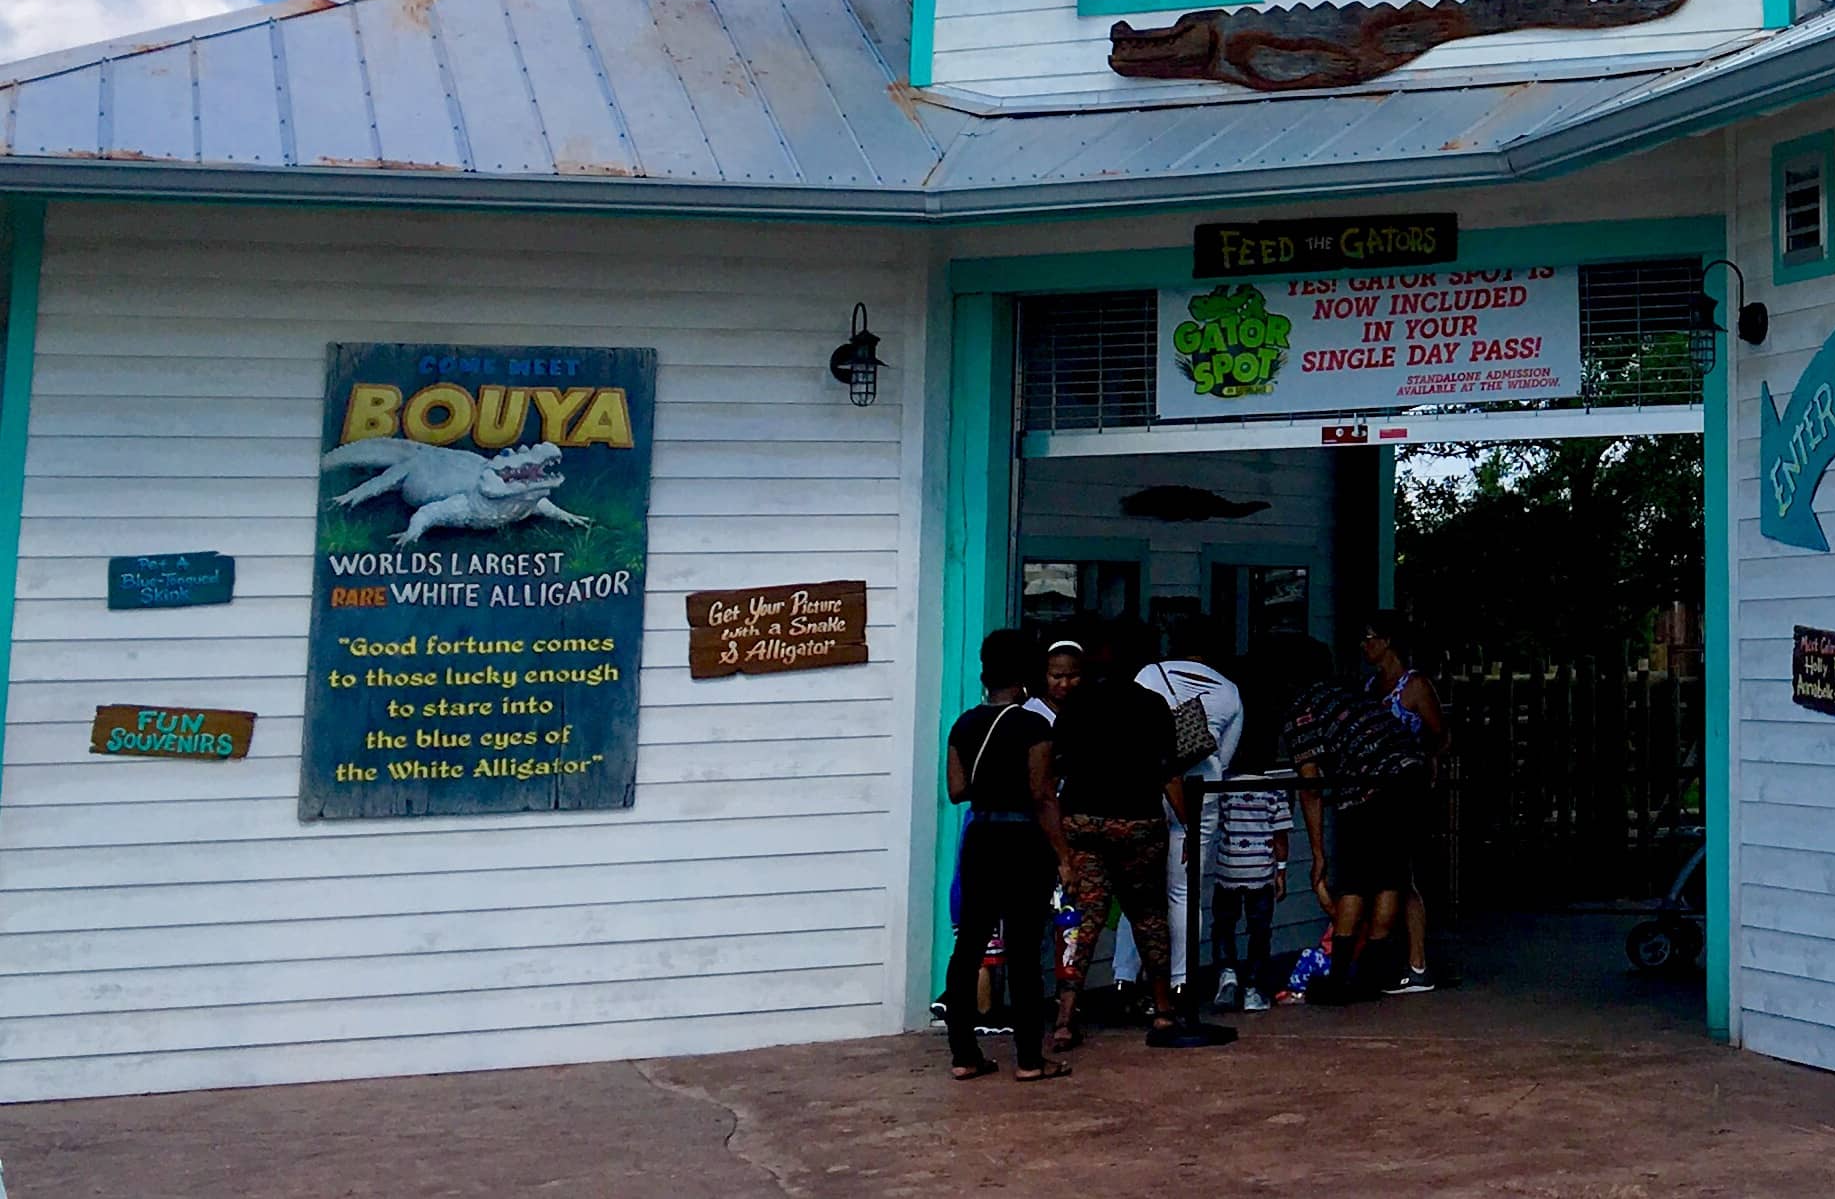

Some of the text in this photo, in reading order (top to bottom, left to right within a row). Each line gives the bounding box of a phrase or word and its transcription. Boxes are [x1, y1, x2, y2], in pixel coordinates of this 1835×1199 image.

[1219, 227, 1436, 269] FEED THE GATORS
[1287, 267, 1554, 296] YES! GATOR SPOT IS
[1312, 286, 1527, 320] NOW INCLUDED
[1173, 313, 1291, 354] GATOR
[1362, 315, 1477, 342] IN YOUR
[419, 355, 496, 375] COME
[1302, 337, 1542, 372] SINGLE DAY PASS!
[1194, 347, 1280, 394] SPOT
[1407, 368, 1551, 384] STANDALONE ADMISSION
[1396, 383, 1456, 396] AVAILABLE
[1460, 382, 1476, 392] AT
[1480, 381, 1503, 391] THE
[340, 382, 634, 448] BOUYA
[329, 552, 564, 576] WORLDS LARGEST
[331, 571, 629, 607] RARE WHITE ALLIGATOR
[709, 591, 842, 626] Get Your Picture
[721, 625, 760, 640] with
[769, 623, 780, 635] a
[426, 636, 524, 655] fortune
[533, 637, 614, 652] comes
[744, 639, 835, 665] Alligator
[329, 664, 619, 689] to those lucky enough
[388, 697, 553, 718] to stare into
[138, 710, 204, 733] FUN
[107, 727, 233, 755] SOUVENIRS
[366, 725, 573, 750] the blue eyes of
[336, 763, 376, 782] the
[388, 760, 464, 781] White
